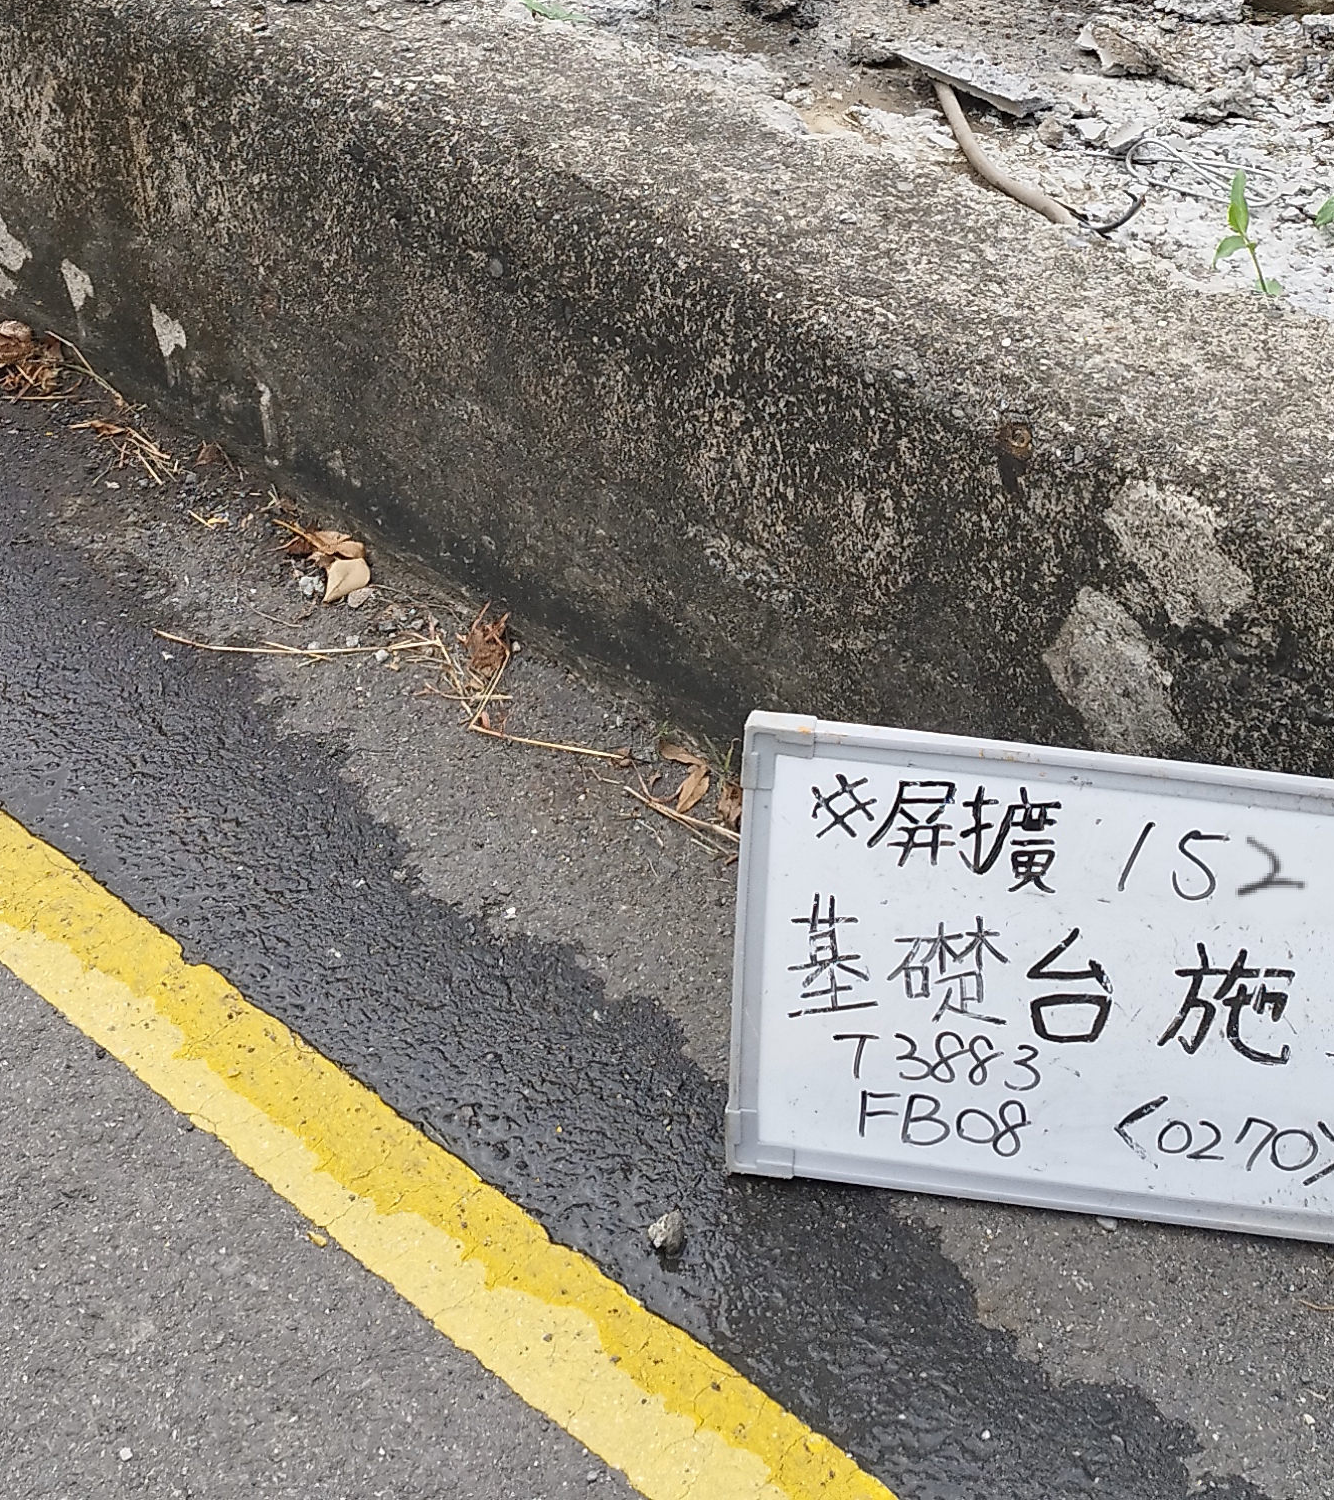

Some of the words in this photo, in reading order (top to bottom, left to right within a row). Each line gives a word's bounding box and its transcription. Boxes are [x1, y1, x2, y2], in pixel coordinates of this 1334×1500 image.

[1117, 821, 1306, 901] 152
[832, 1030, 1041, 1091] T3883
[858, 1089, 1033, 1158] FB08
